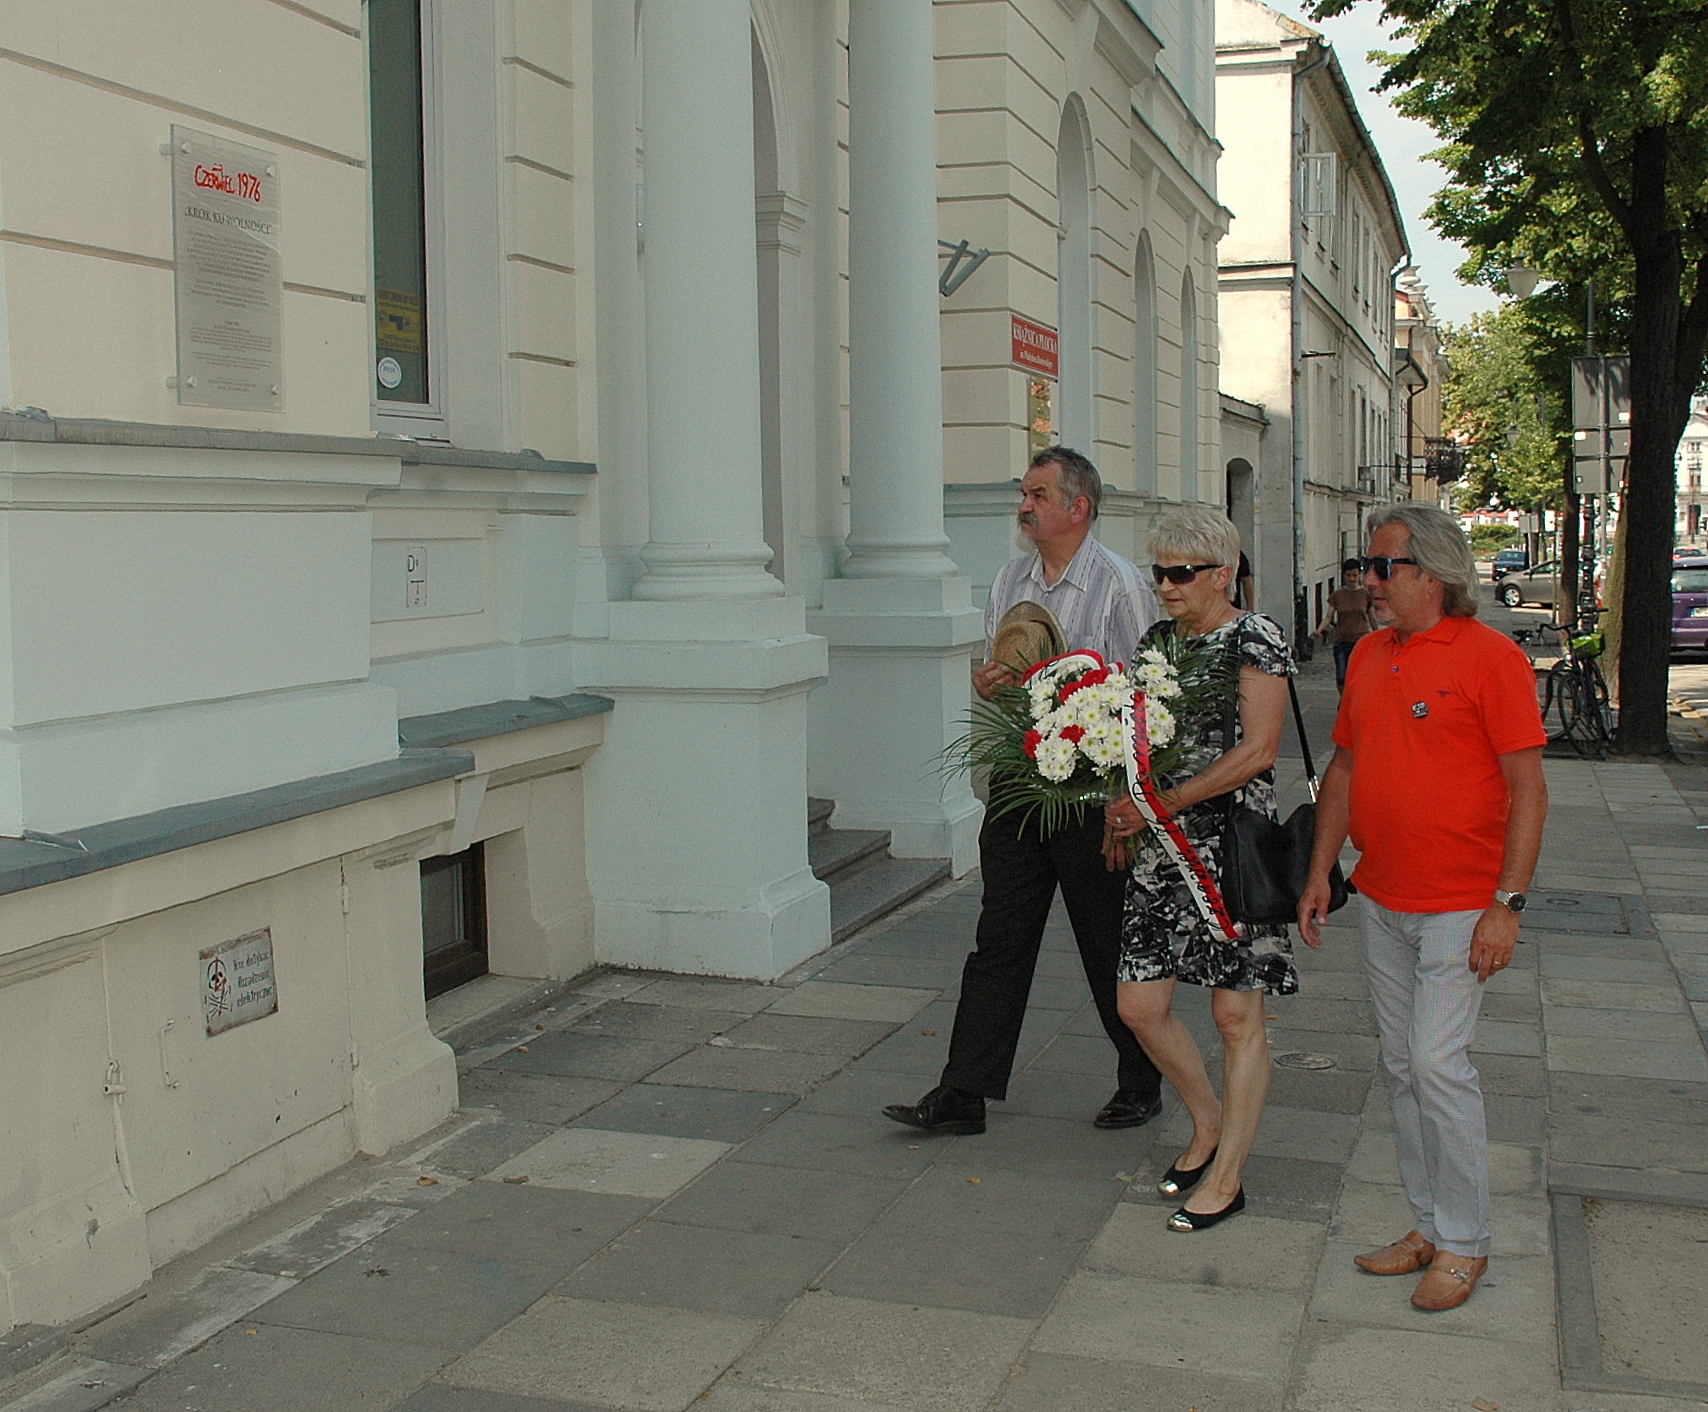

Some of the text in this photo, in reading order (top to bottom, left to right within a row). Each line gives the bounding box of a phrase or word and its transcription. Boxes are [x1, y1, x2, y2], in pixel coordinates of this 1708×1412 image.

[237, 173, 261, 202] 1976
[213, 211, 225, 225] KU
[1039, 334, 1058, 354] PŁOCKA
[233, 958, 245, 972] Nie
